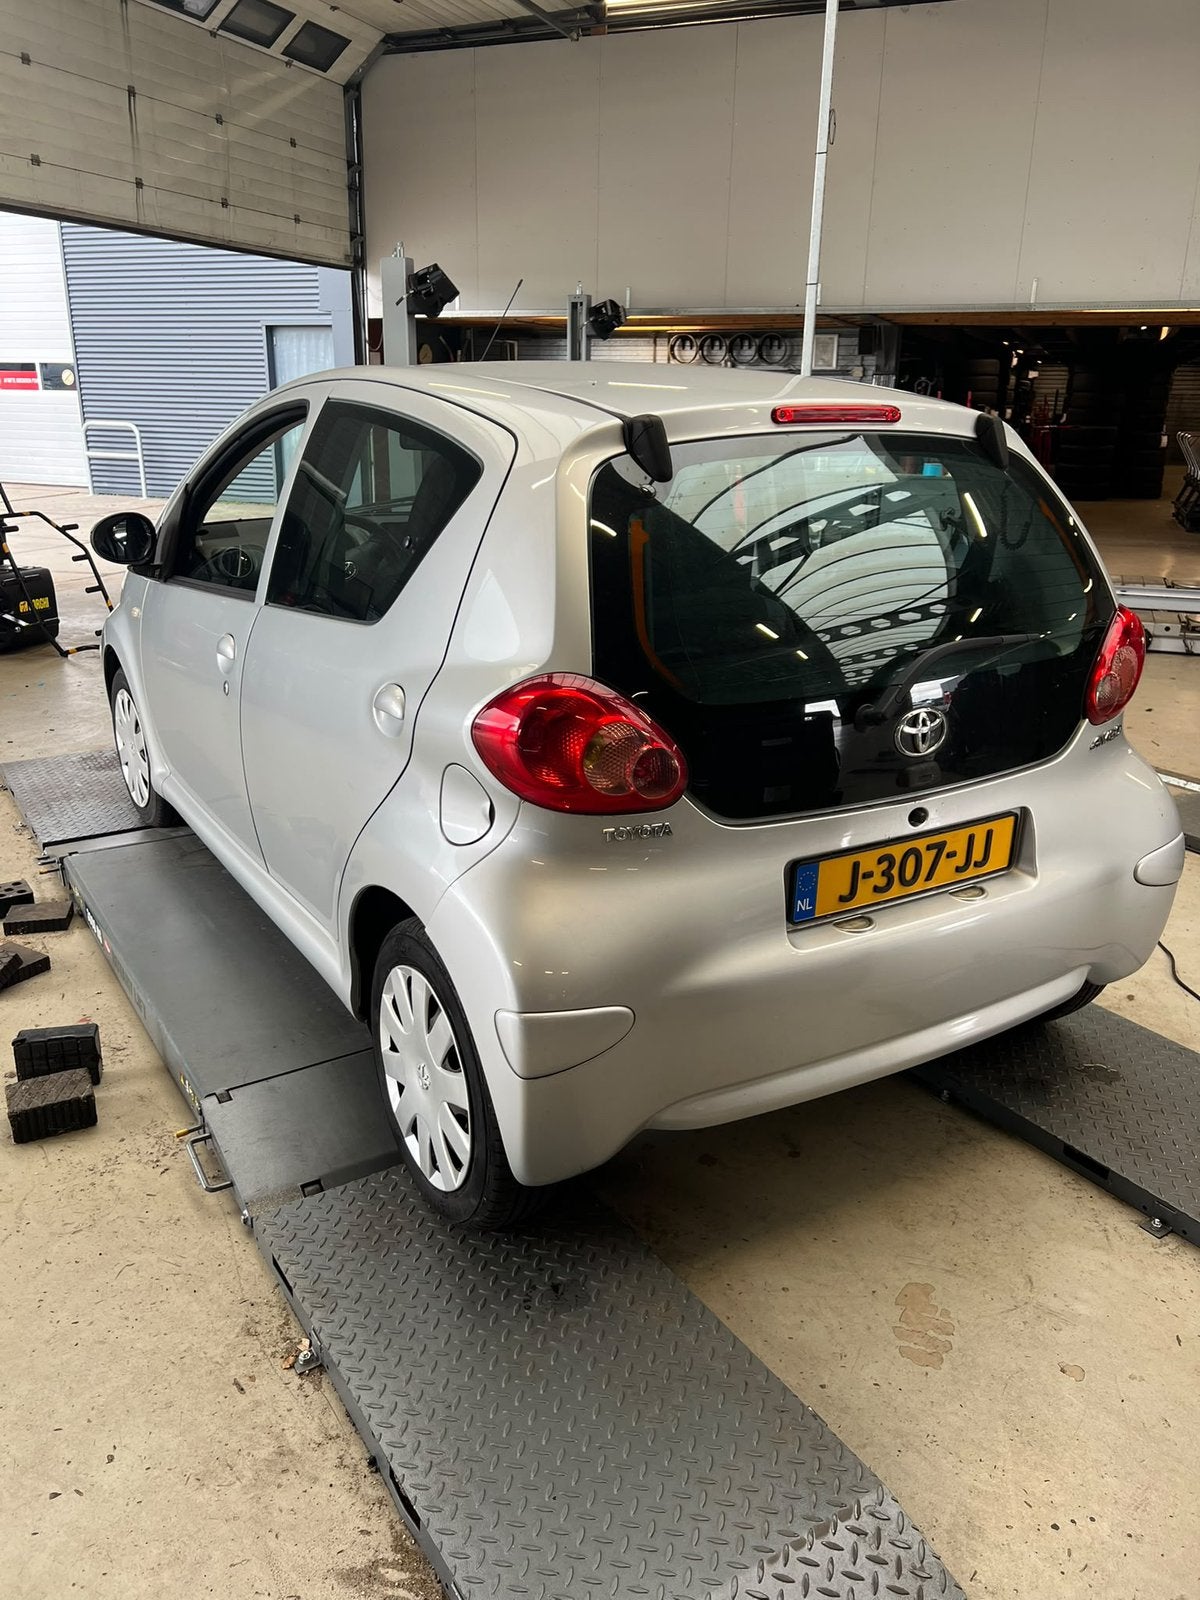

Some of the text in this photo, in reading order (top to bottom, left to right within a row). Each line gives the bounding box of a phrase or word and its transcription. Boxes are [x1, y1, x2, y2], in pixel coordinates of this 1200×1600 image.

[602, 822, 673, 842] TOYOTA
[838, 828, 994, 903] J-307-JJ
[796, 898, 813, 912] NL
